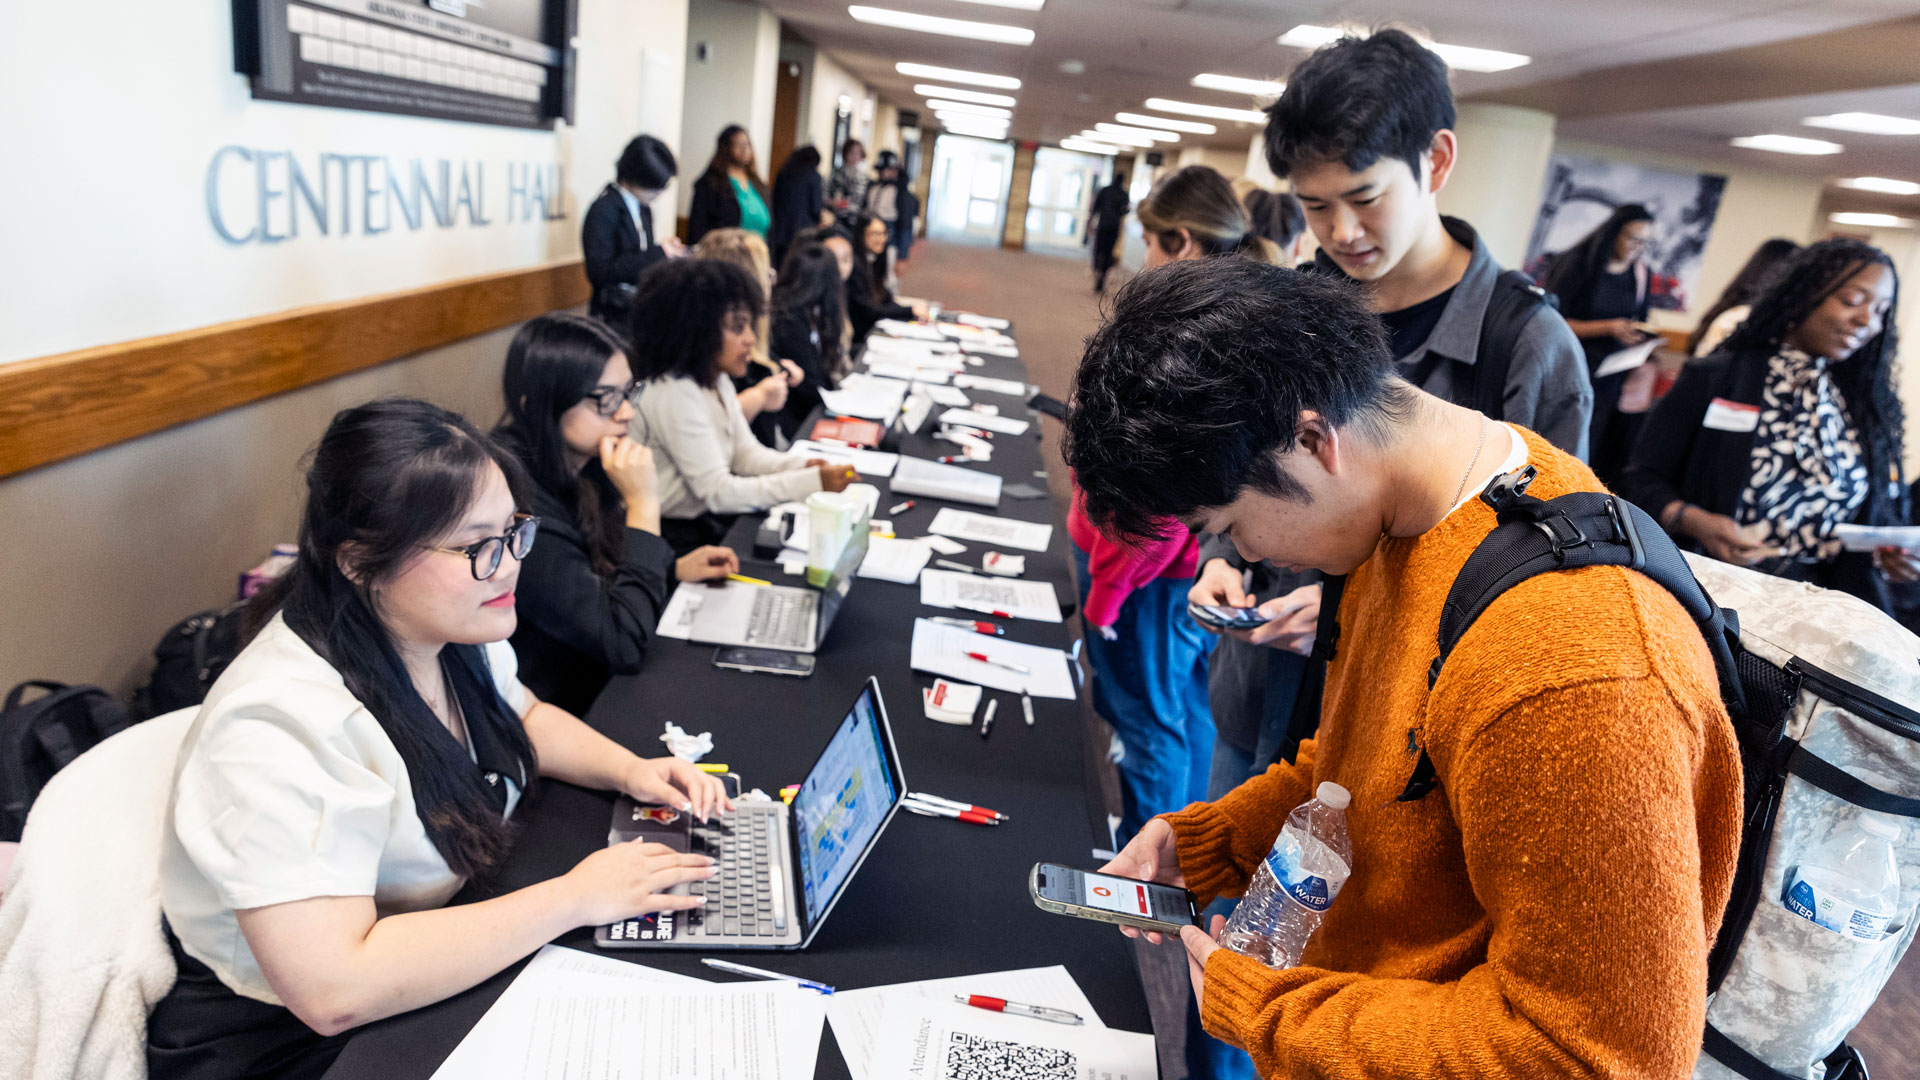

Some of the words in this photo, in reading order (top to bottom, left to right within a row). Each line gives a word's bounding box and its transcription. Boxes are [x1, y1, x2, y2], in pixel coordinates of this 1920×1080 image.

[506, 160, 568, 223] HALL
[1295, 885, 1327, 905] WATER
[1787, 896, 1814, 920] WATER
[626, 922, 640, 939] NOT
[909, 1017, 931, 1077] Attendance
